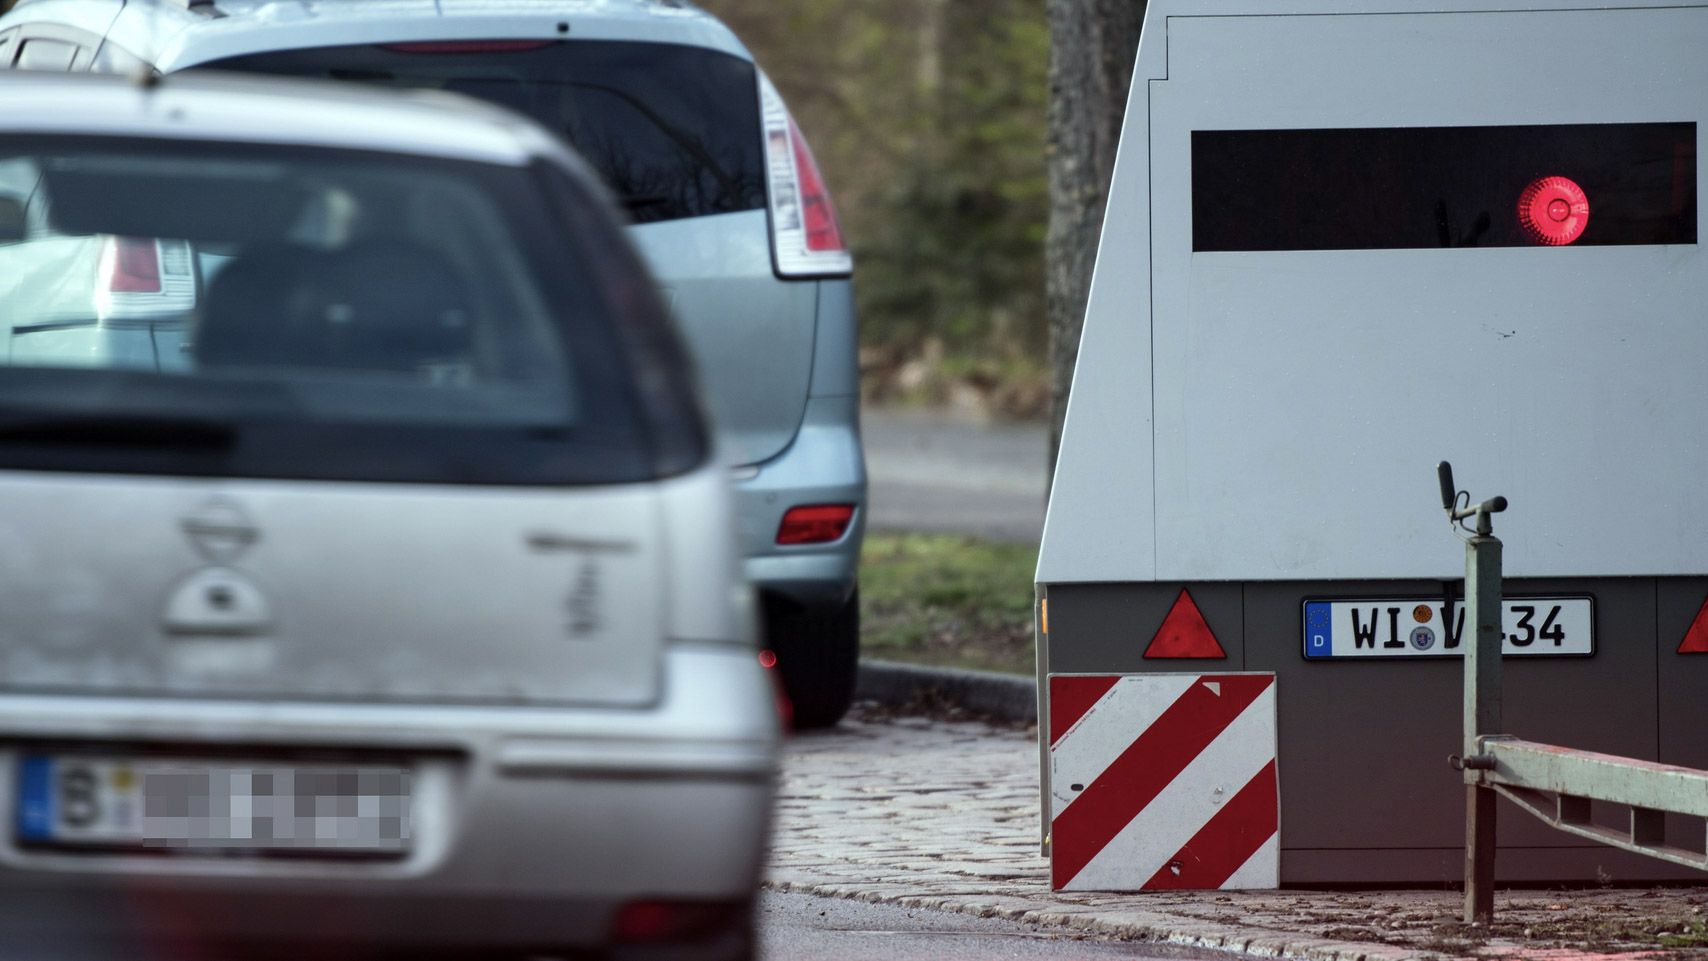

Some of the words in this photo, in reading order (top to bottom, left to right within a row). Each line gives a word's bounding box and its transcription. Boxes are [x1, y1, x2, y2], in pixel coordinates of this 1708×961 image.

[1314, 635, 1324, 647] D
[1351, 607, 1405, 649] WI
[1500, 605, 1566, 647] 34
